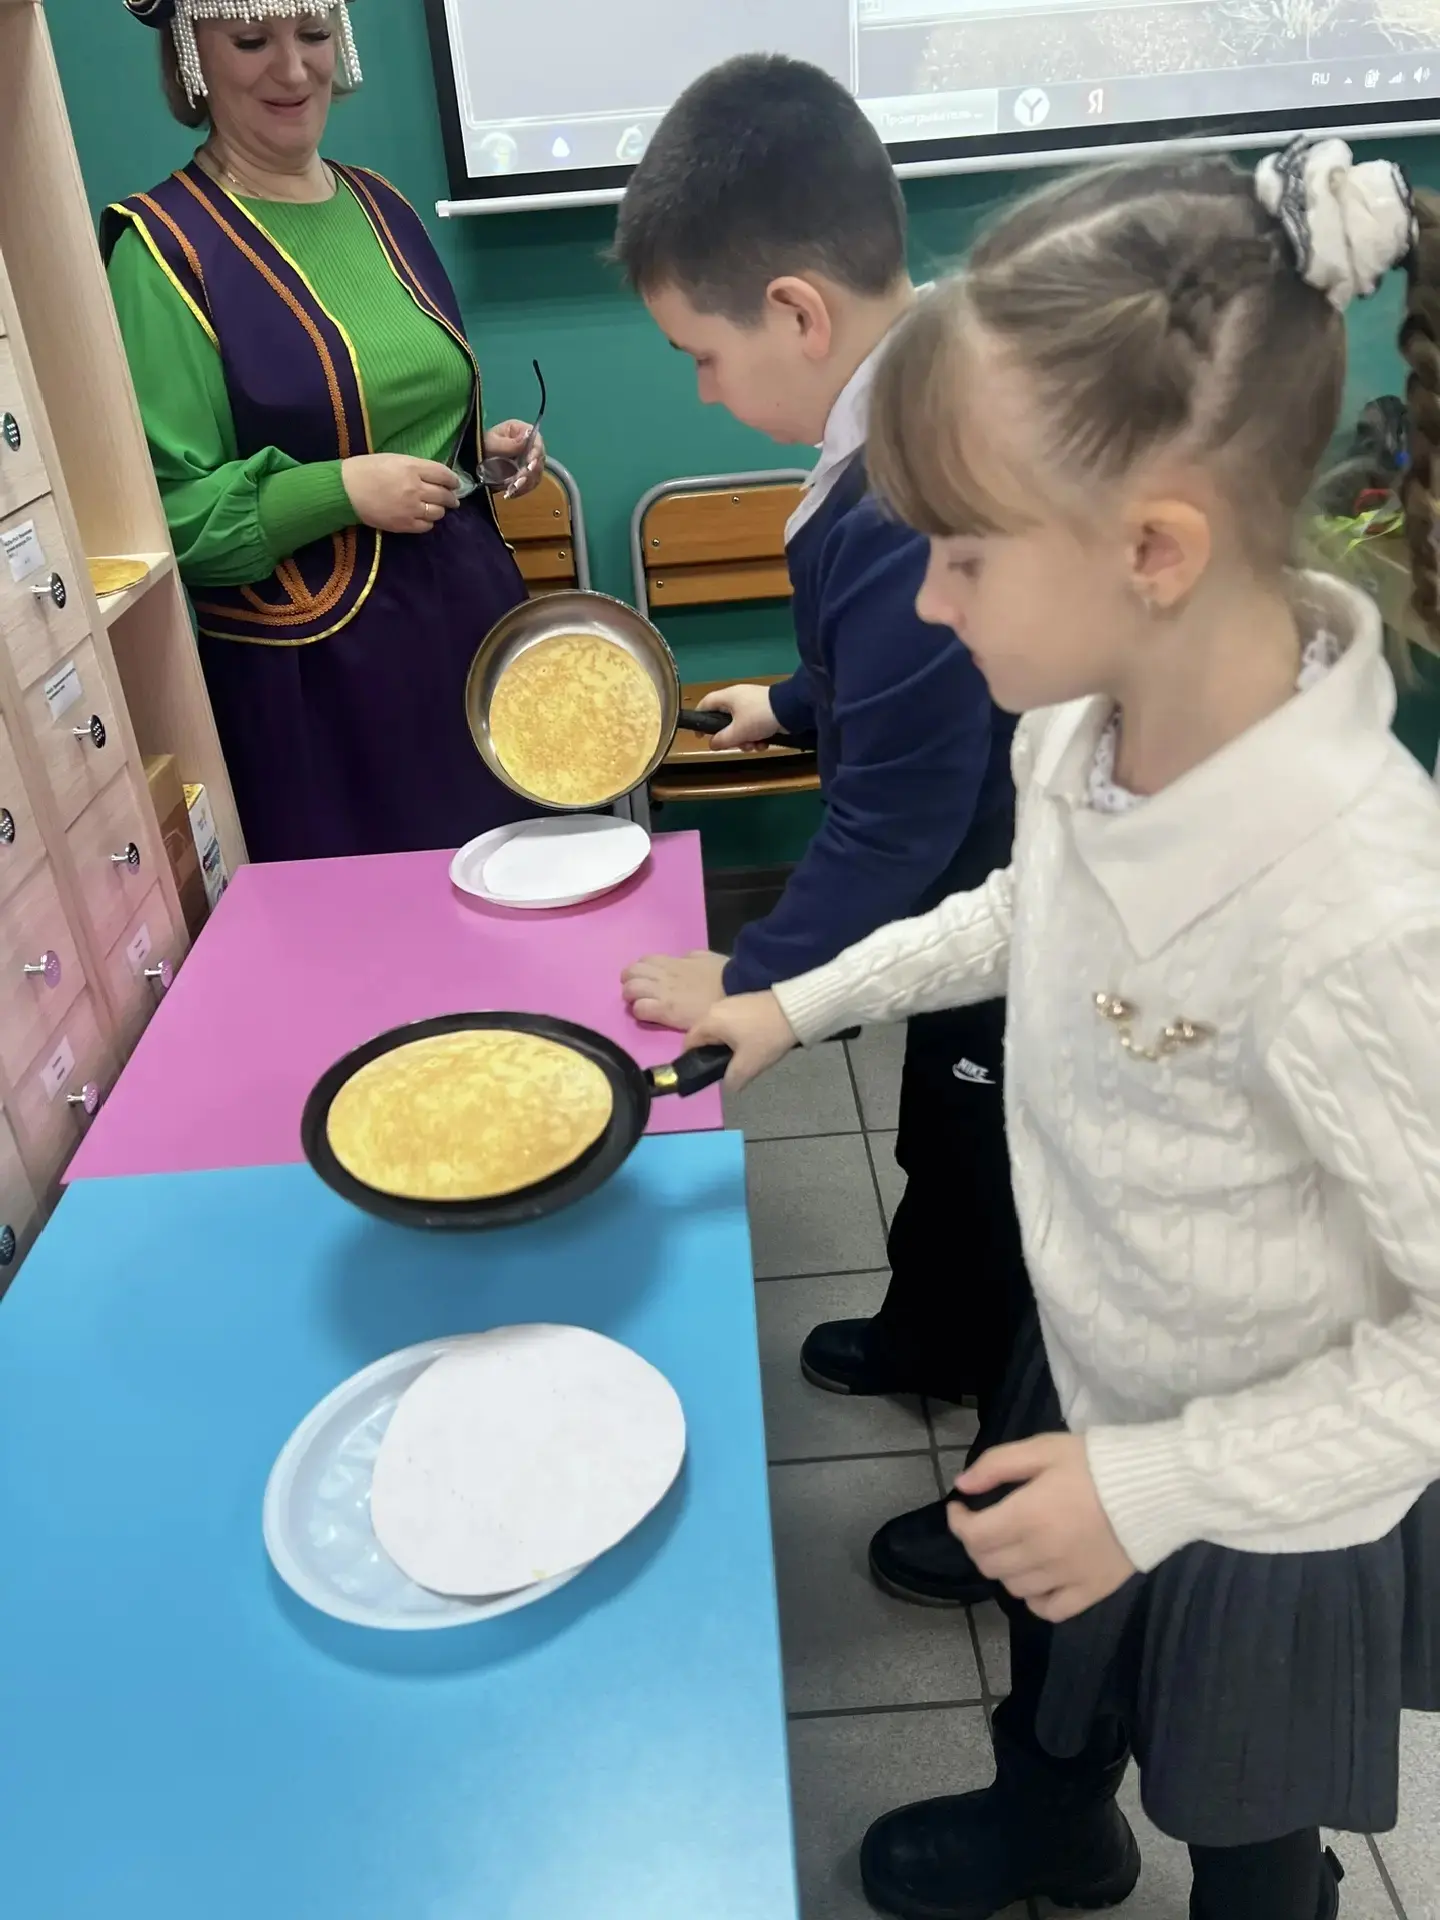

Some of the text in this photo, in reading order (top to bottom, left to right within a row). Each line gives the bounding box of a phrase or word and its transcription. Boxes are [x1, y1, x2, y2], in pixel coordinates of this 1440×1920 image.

[1311, 72, 1331, 86] RU
[1087, 88, 1104, 114] Я
[957, 1057, 990, 1078] NIKE
